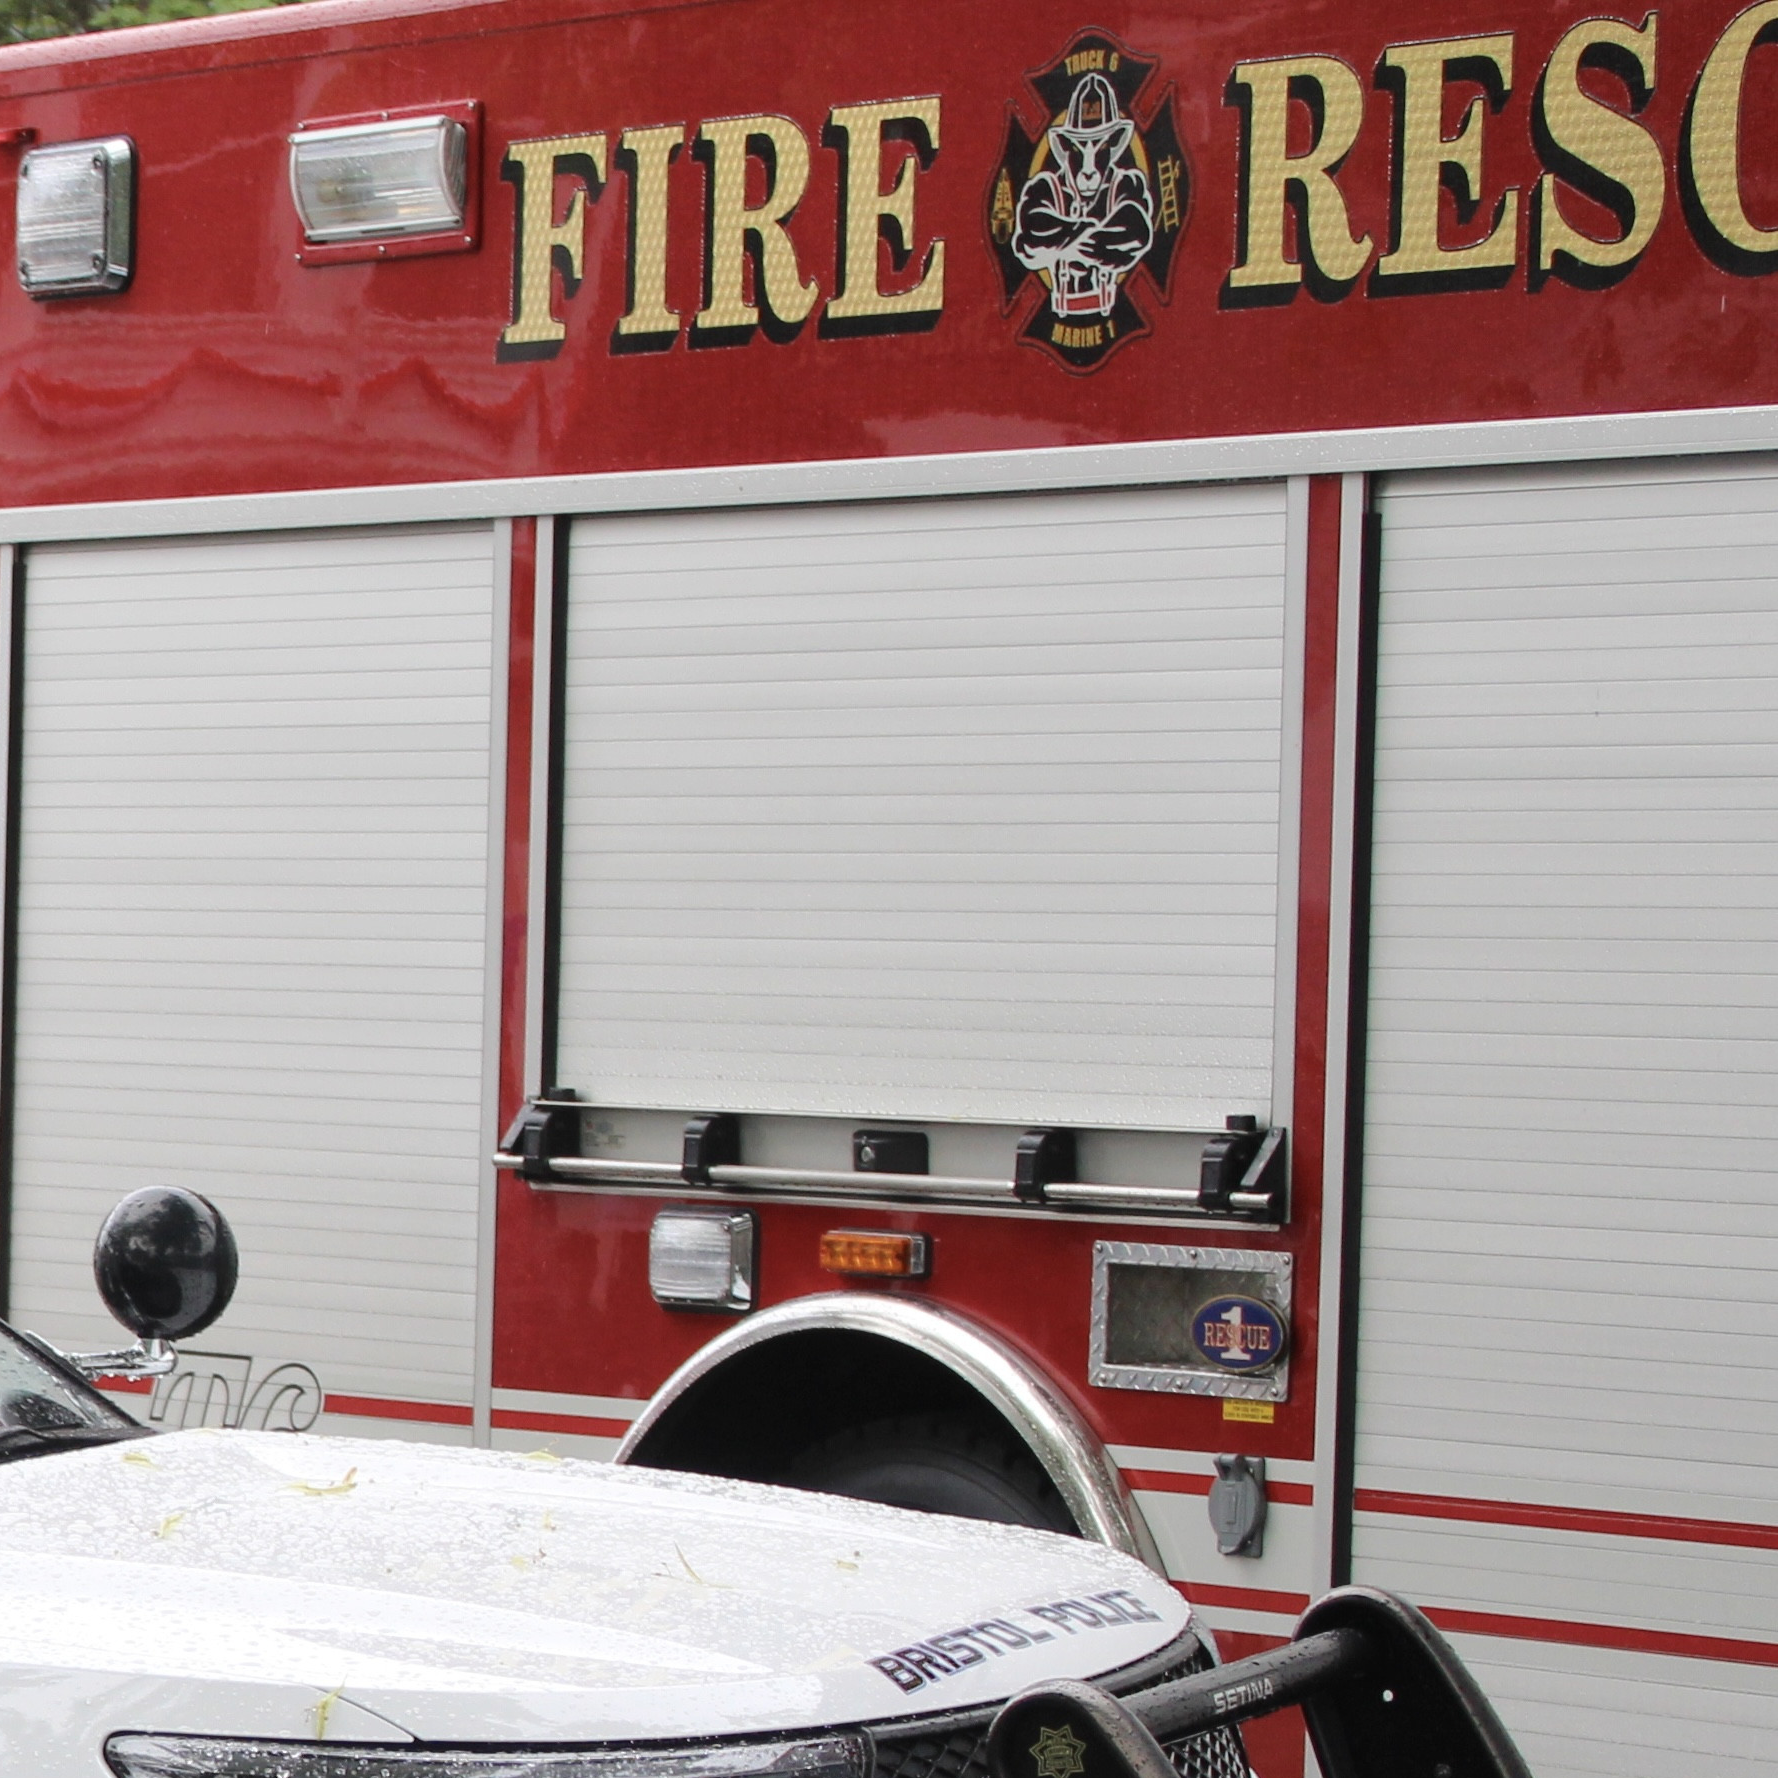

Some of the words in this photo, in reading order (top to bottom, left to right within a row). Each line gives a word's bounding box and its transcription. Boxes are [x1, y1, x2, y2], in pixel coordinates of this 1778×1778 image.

[1064, 49, 1105, 76] TRUCK
[495, 95, 944, 364] FIRE
[1051, 323, 1103, 348] MARINE
[1106, 319, 1115, 338] 1
[1203, 1322, 1271, 1350] RESCUE
[1220, 1305, 1251, 1361] 1
[865, 1617, 1057, 1695] BRISTOL
[1023, 1589, 1164, 1635] POLICE
[1213, 1678, 1274, 1715] SETINA
